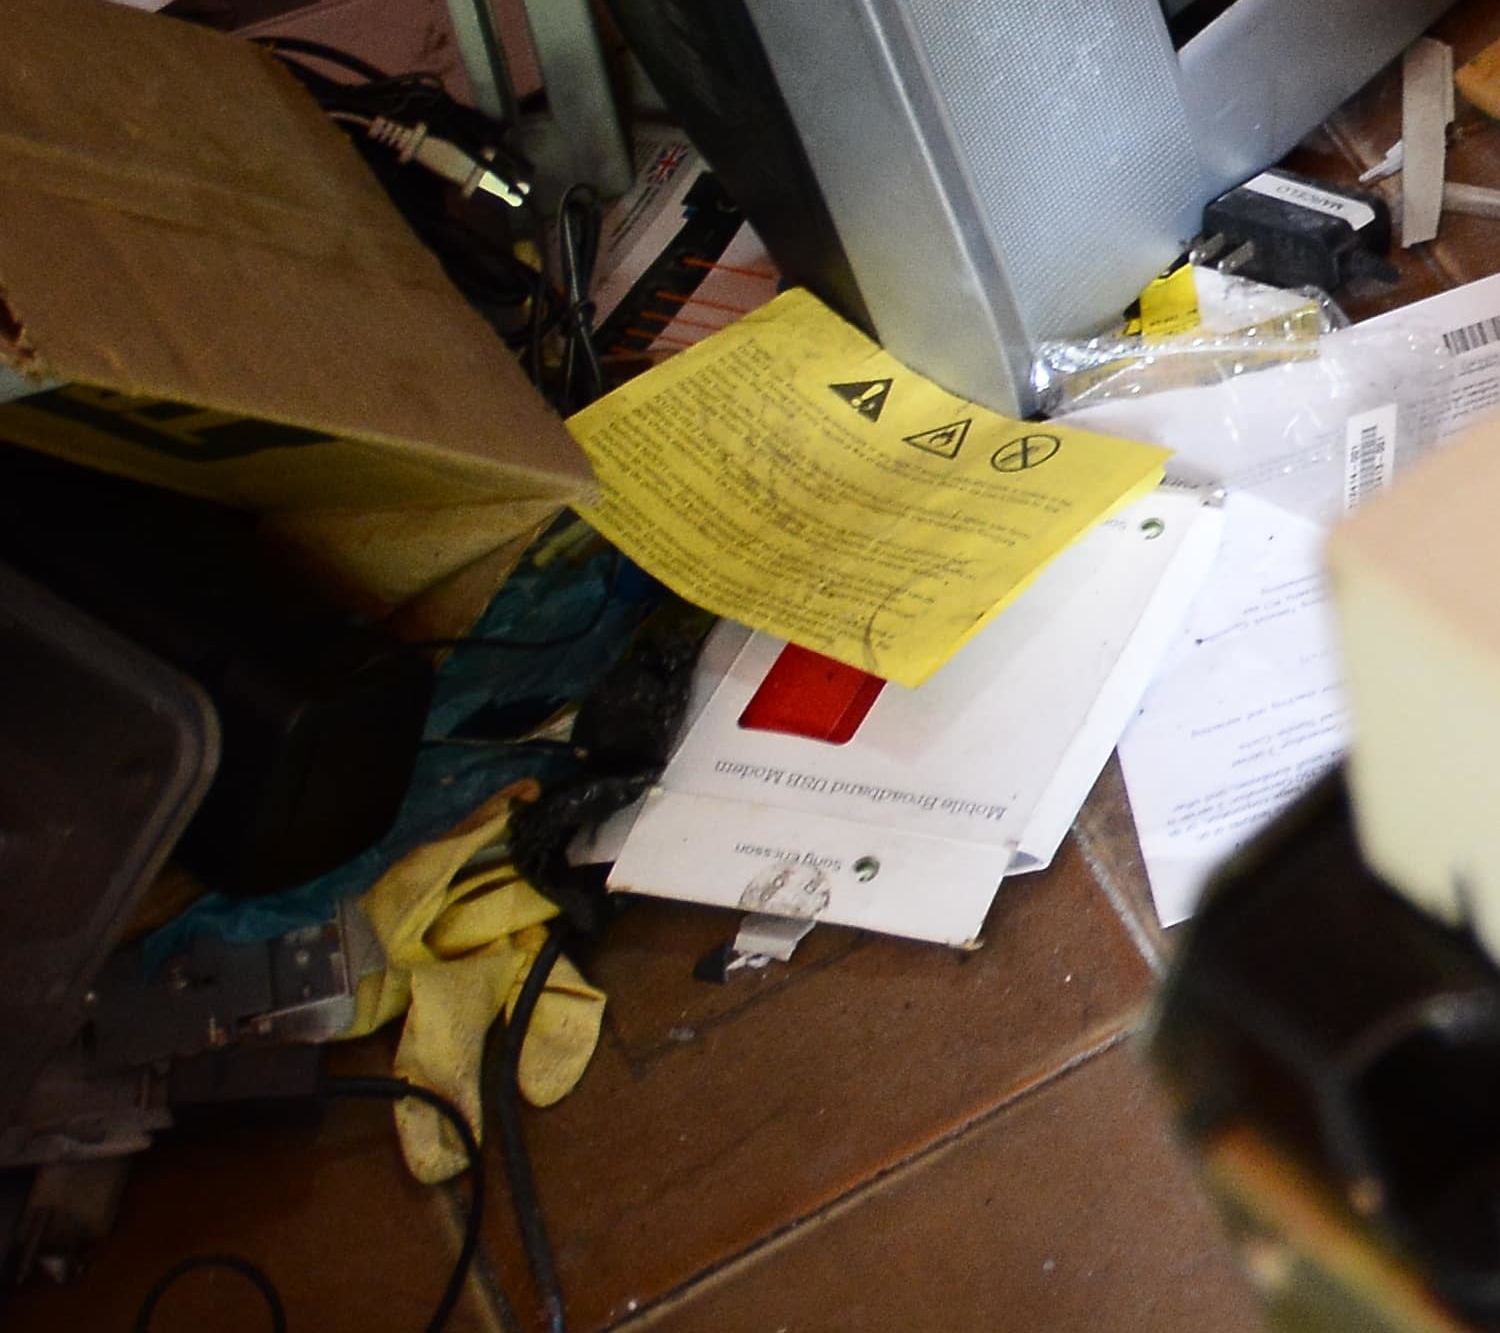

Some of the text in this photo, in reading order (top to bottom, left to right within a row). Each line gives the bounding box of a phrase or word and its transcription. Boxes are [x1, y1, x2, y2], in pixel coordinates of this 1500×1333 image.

[1274, 183, 1344, 211] MARCELO
[712, 757, 1006, 822] Mobile Broadband USB Modem
